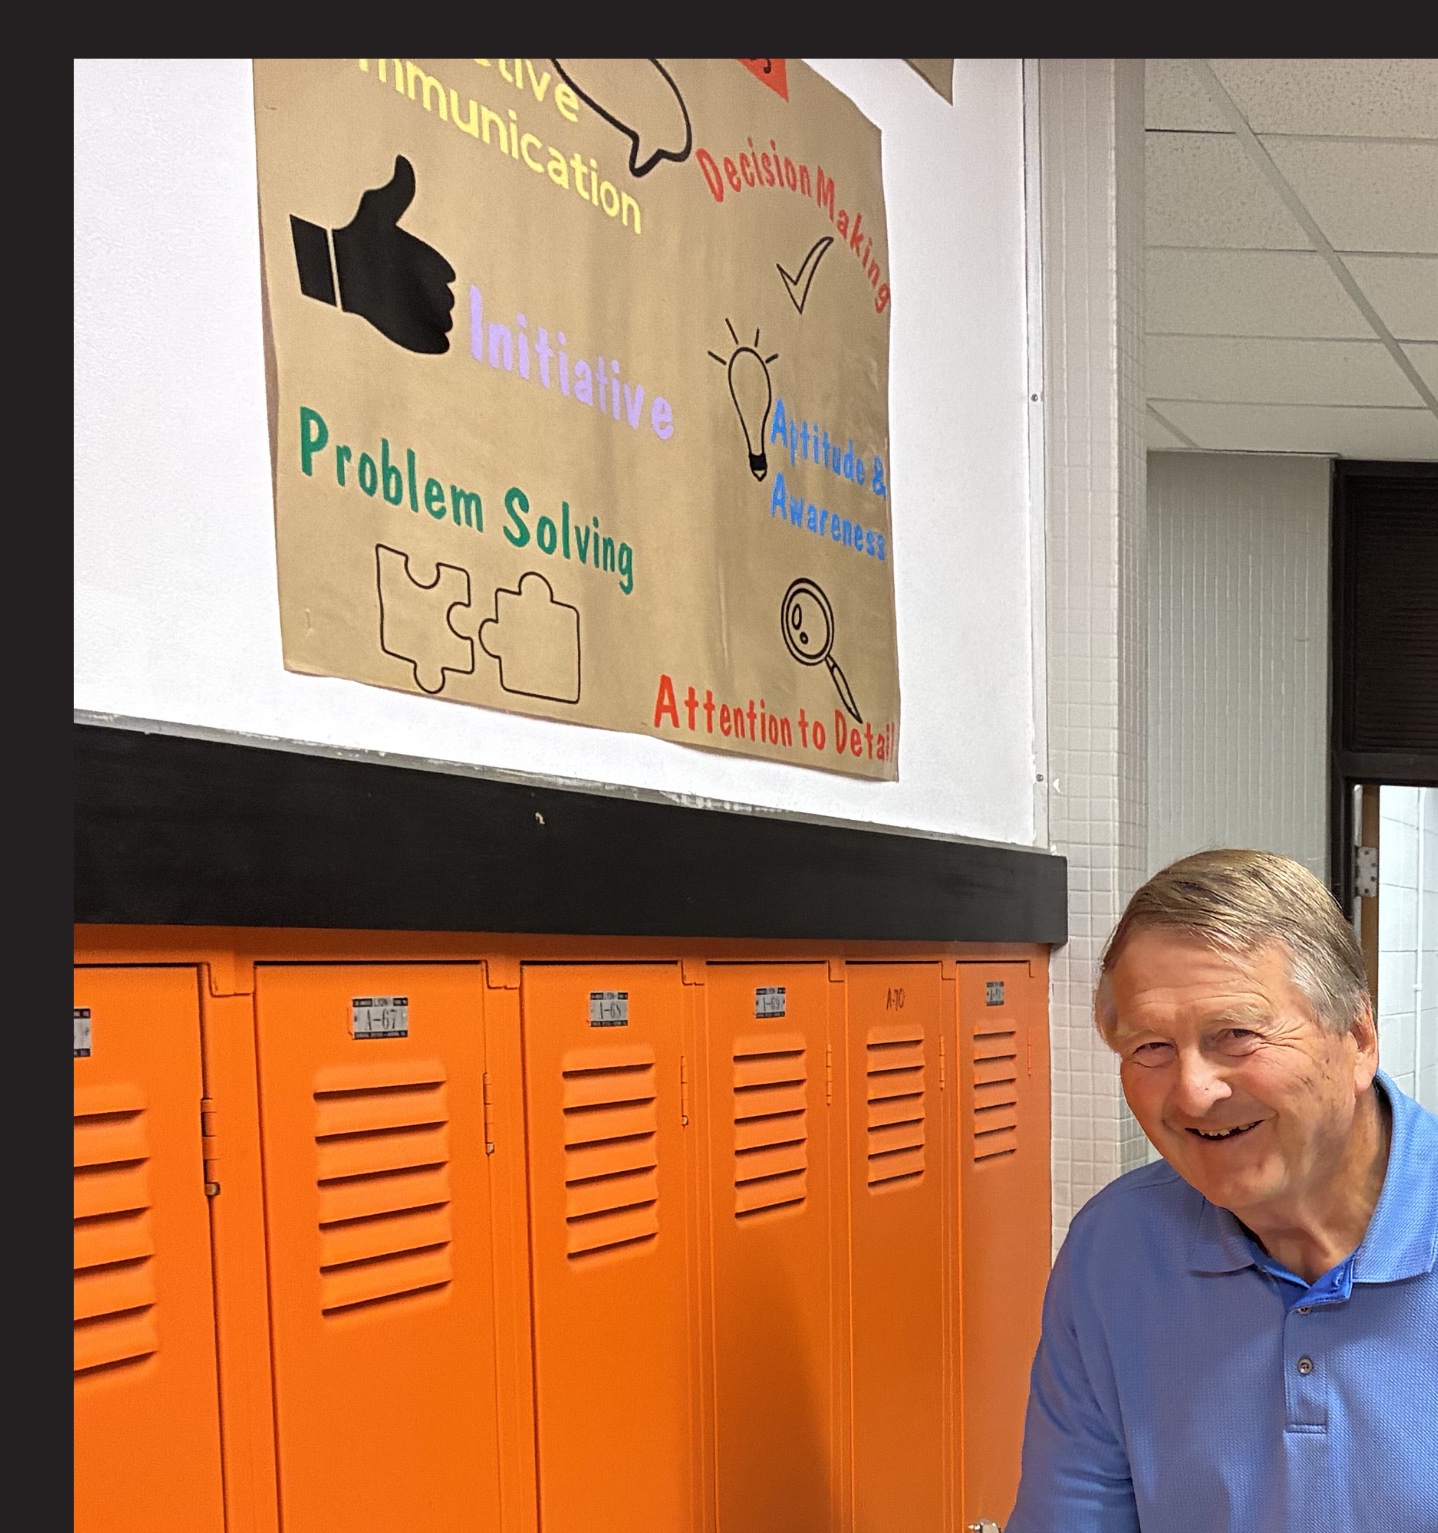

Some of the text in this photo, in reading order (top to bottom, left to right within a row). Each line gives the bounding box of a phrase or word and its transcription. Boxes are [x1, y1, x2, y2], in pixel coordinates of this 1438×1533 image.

[695, 137, 891, 314] Decision Making
[470, 284, 674, 440] Initiative
[300, 406, 634, 595] Problem Solving
[771, 398, 887, 499] Aptitude &
[770, 472, 885, 561] Awareness
[654, 674, 894, 763] Attention to Detail
